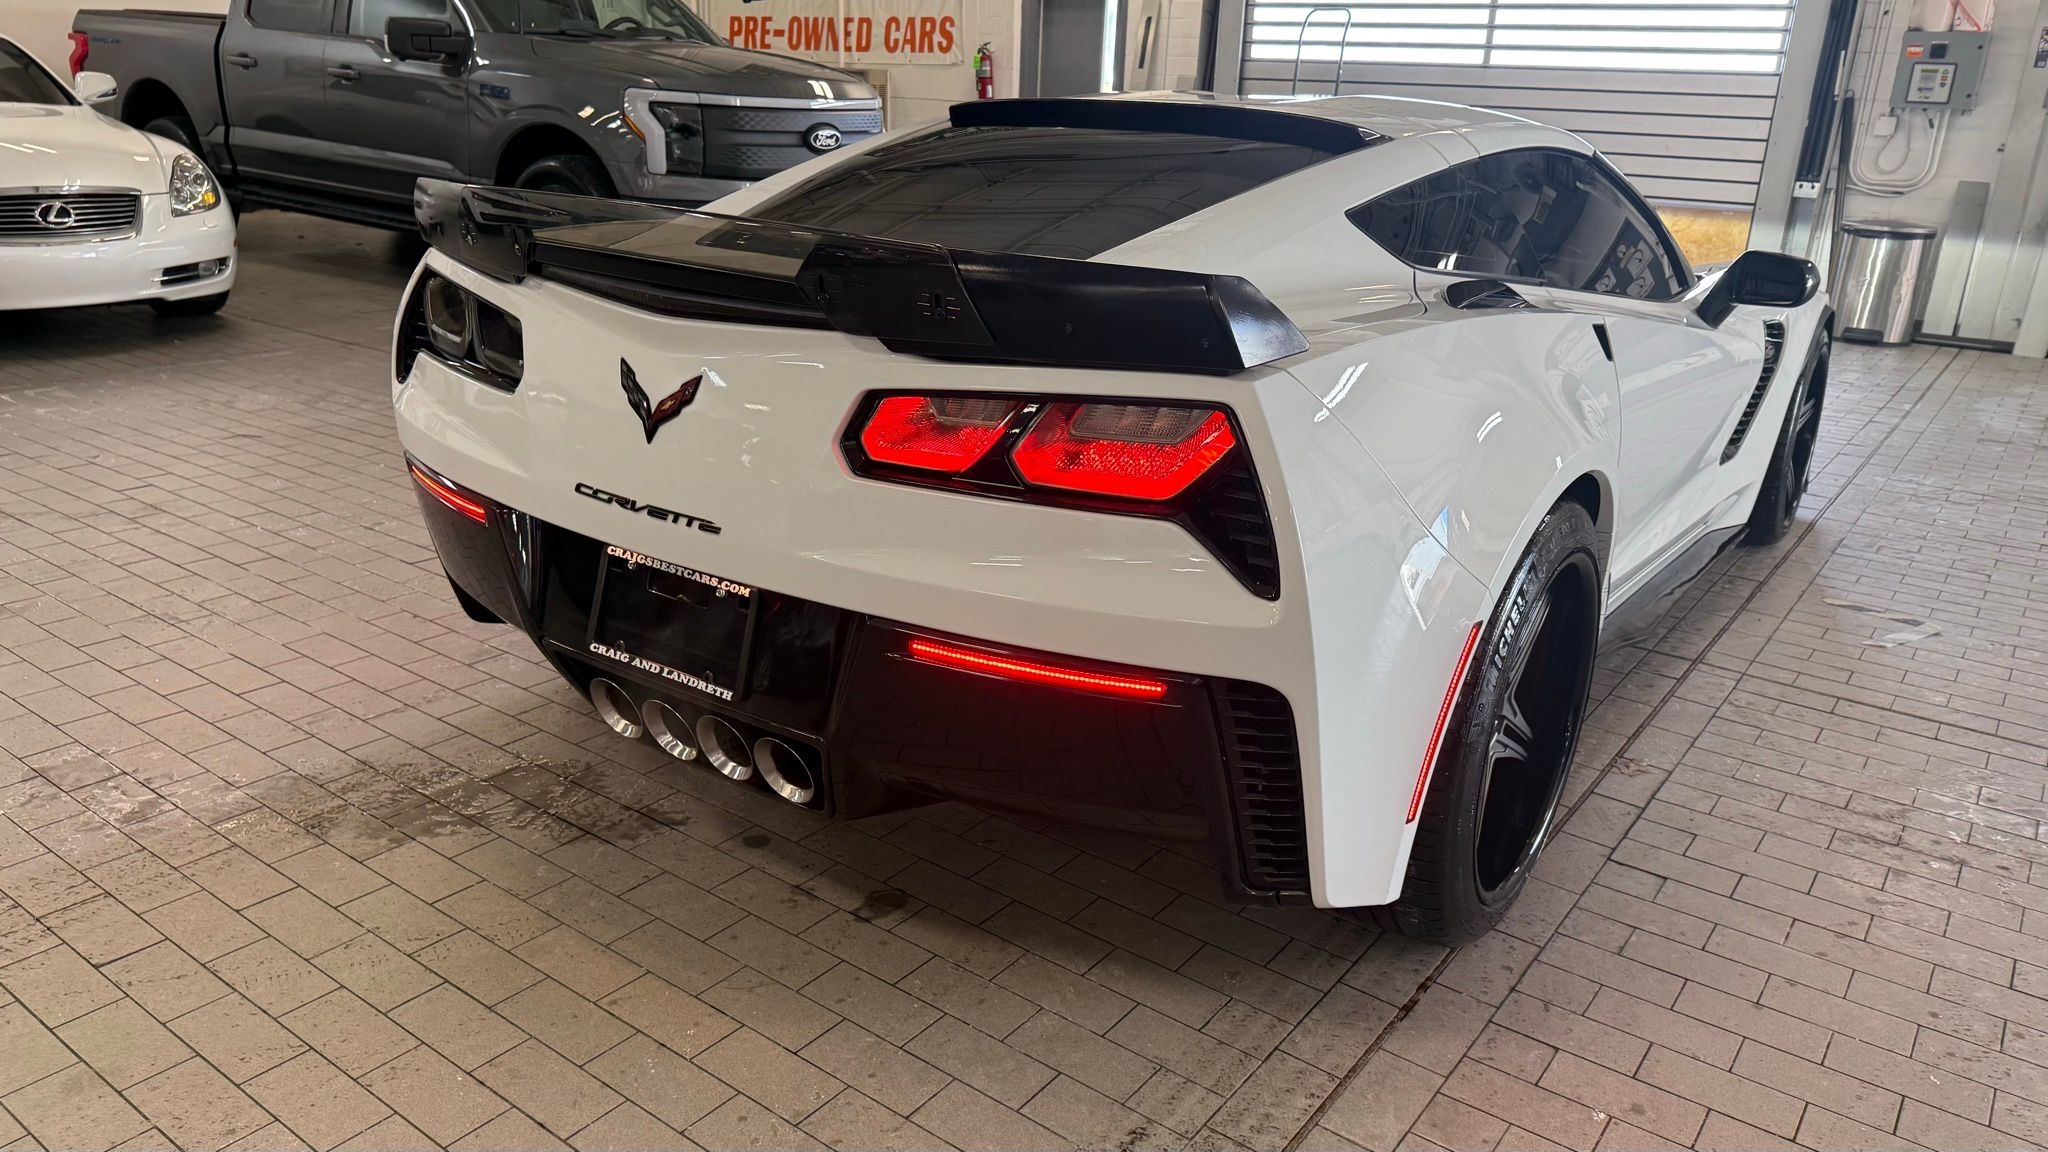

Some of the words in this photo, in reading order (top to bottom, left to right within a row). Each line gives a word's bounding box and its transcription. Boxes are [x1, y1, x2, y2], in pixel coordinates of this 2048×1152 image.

[729, 16, 872, 53] PRE-OWNED
[884, 16, 956, 54] CARS
[575, 482, 722, 535] CORVETTE
[607, 545, 751, 598] CRAIGSBESTCARS.COM
[589, 642, 630, 663] CRAIG
[631, 657, 660, 674] AND
[662, 667, 733, 701] LANDRETH
